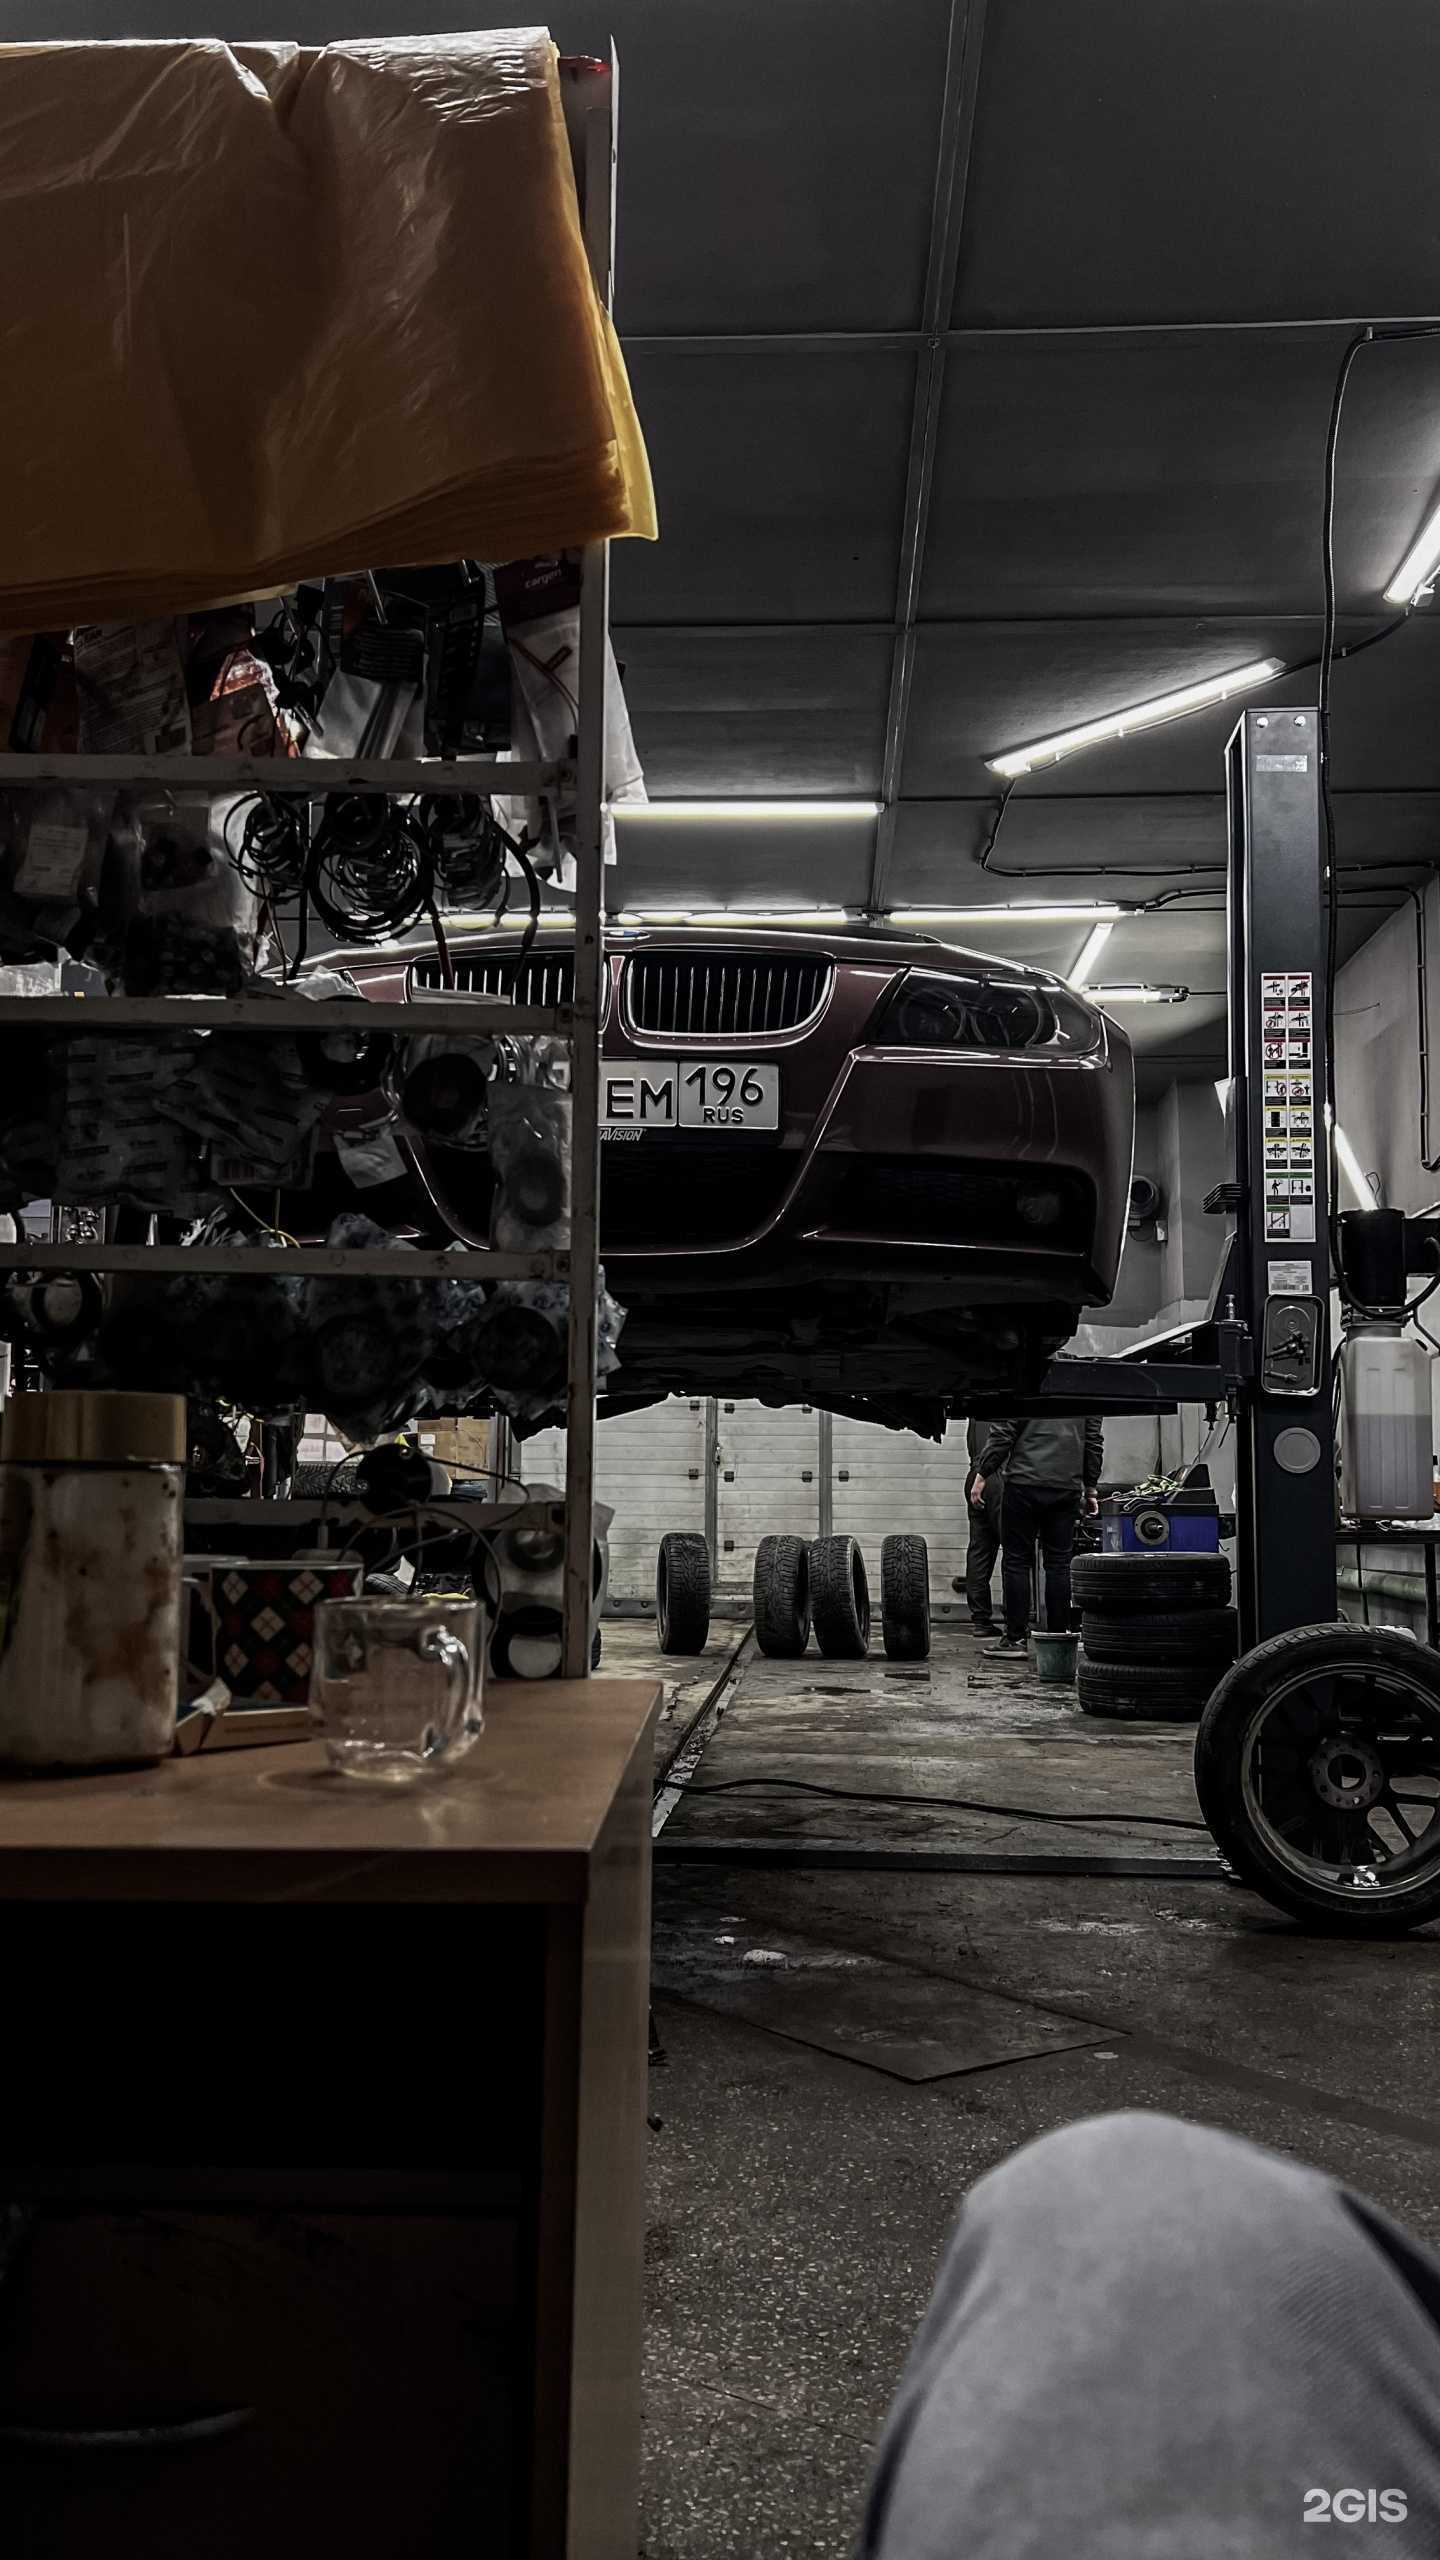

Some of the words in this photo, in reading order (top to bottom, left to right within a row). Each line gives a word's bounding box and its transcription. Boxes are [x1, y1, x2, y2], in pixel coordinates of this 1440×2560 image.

[606, 1077, 673, 1120] EM
[685, 1066, 764, 1107] 196
[703, 1106, 744, 1124] RUS
